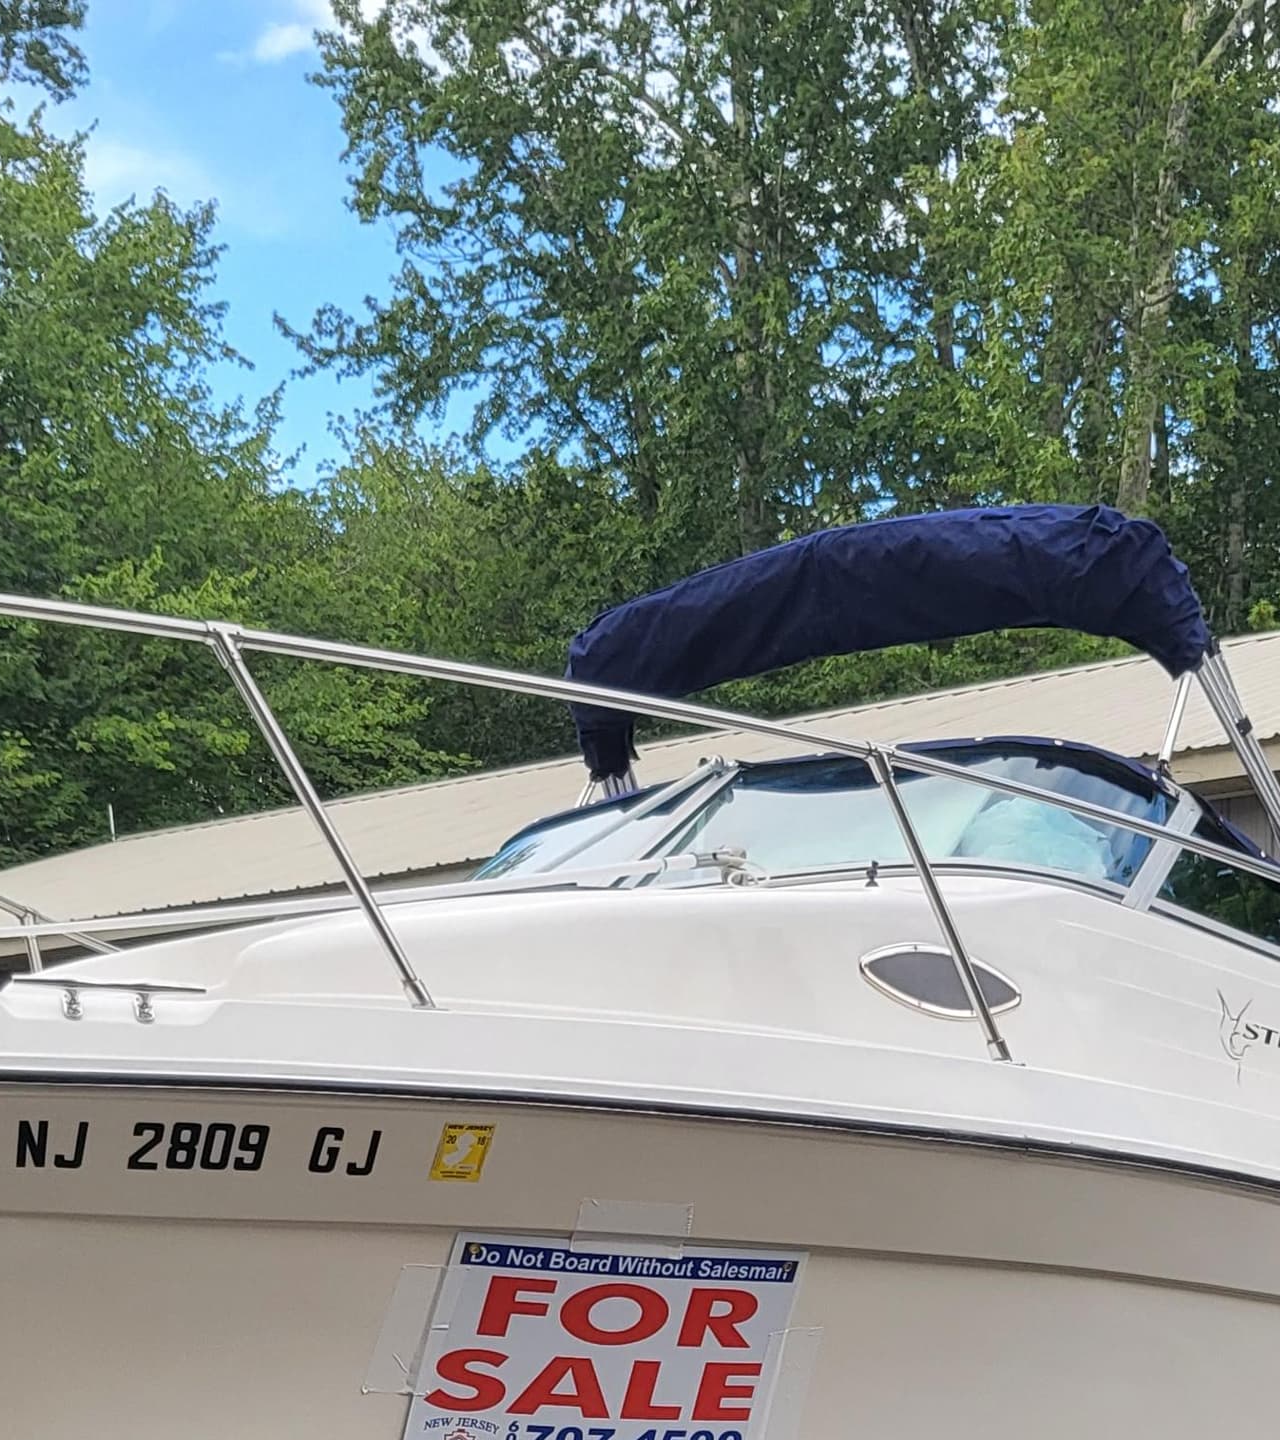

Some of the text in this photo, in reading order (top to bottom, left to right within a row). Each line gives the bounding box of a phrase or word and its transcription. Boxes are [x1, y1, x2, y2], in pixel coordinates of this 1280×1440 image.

[16, 1120, 382, 1176] NJ 2809 GJ
[470, 1249, 789, 1281] Do Not Board Without Salesman
[475, 1275, 759, 1349] FOR
[422, 1349, 763, 1422] SALE
[424, 1417, 500, 1435] NEW JERSEY
